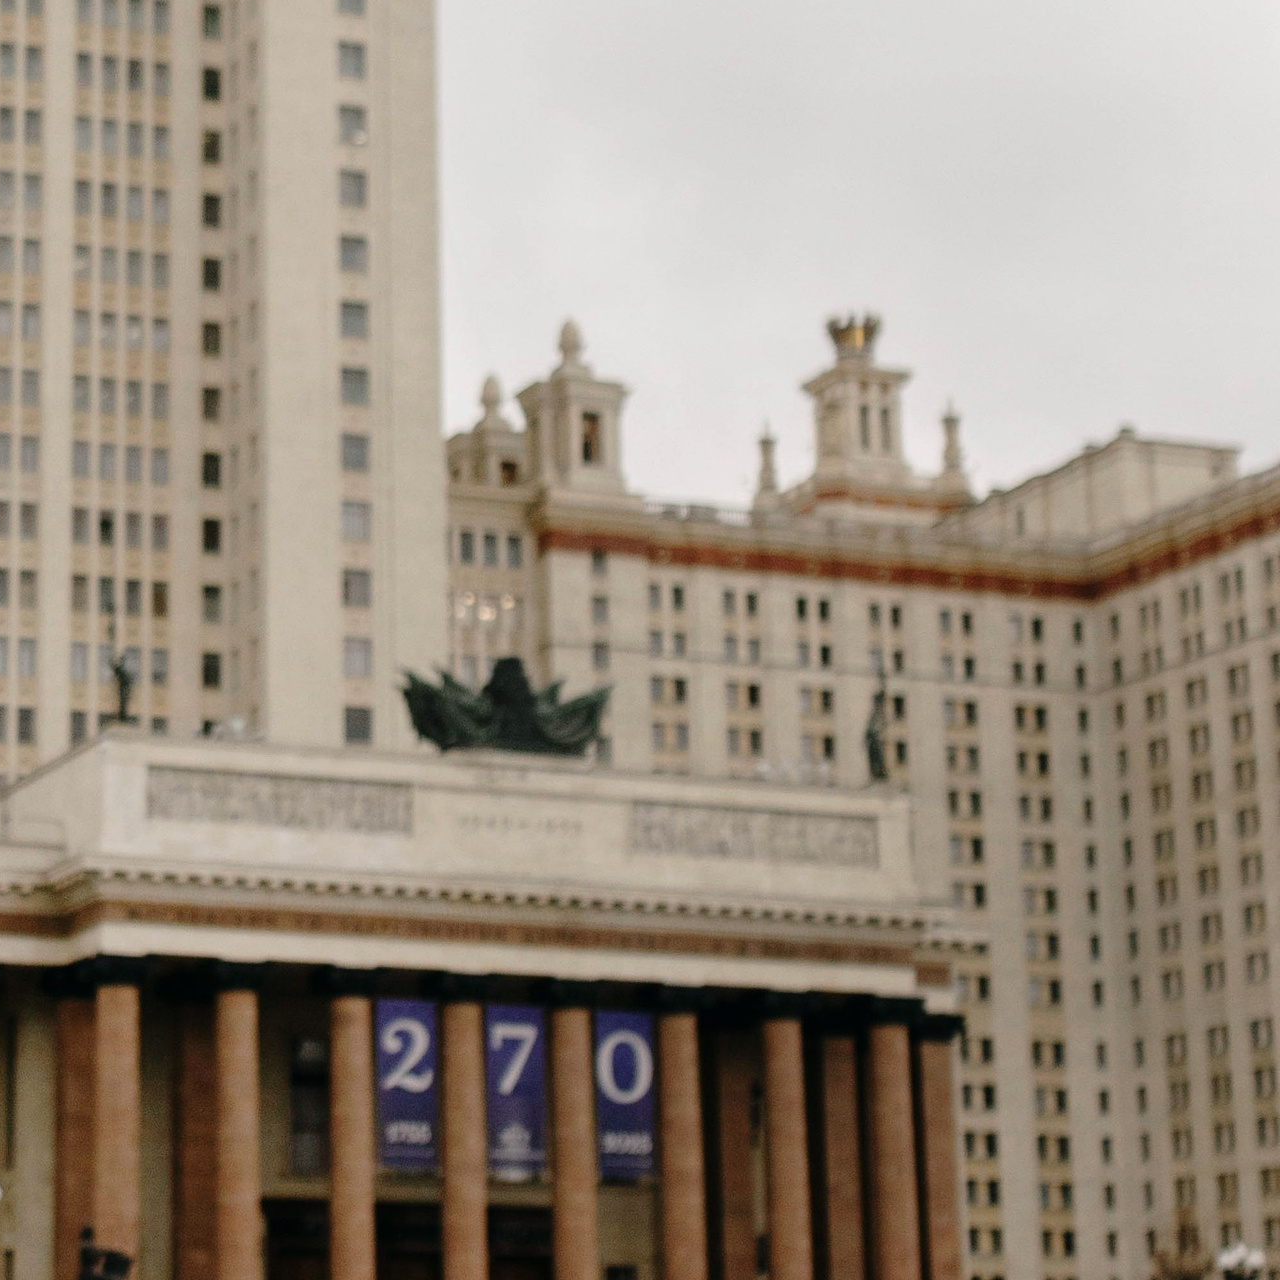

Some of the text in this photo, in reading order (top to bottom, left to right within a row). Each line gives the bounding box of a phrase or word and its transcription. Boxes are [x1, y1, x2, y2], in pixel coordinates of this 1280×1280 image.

[380, 1018, 653, 1104] 2 7 0
